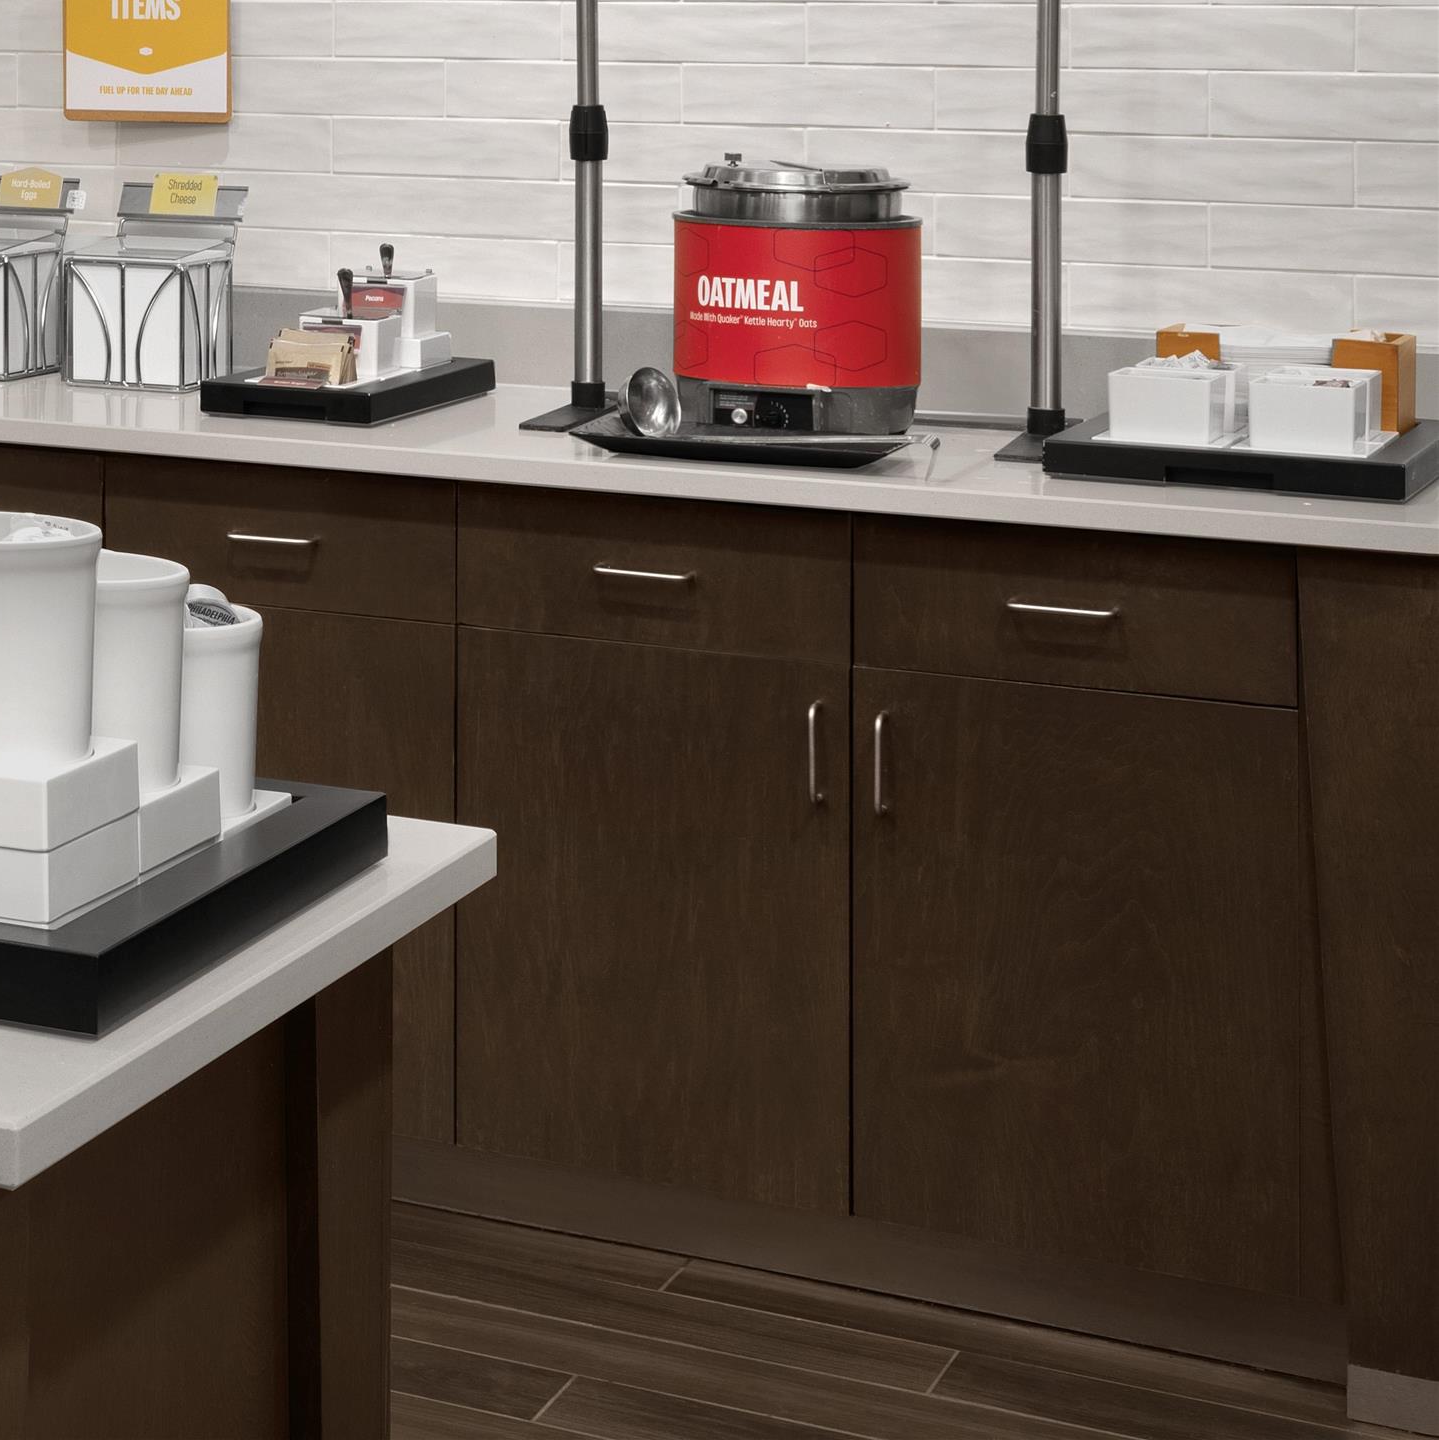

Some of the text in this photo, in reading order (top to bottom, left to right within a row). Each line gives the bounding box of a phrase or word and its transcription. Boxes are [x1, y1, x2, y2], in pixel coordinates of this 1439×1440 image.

[99, 85, 193, 96] FUEL UP FOR THE DAY AHEAD
[11, 178, 51, 189] Hard-Boiled
[167, 178, 203, 191] Shredded
[20, 189, 37, 200] Eggs
[169, 192, 197, 205] Cheese
[697, 274, 805, 313] OATMEAL
[744, 316, 766, 326] Kettle
[767, 317, 794, 329] Hearty
[799, 318, 818, 328] Oats
[187, 602, 236, 625] PHILADELPHIA
